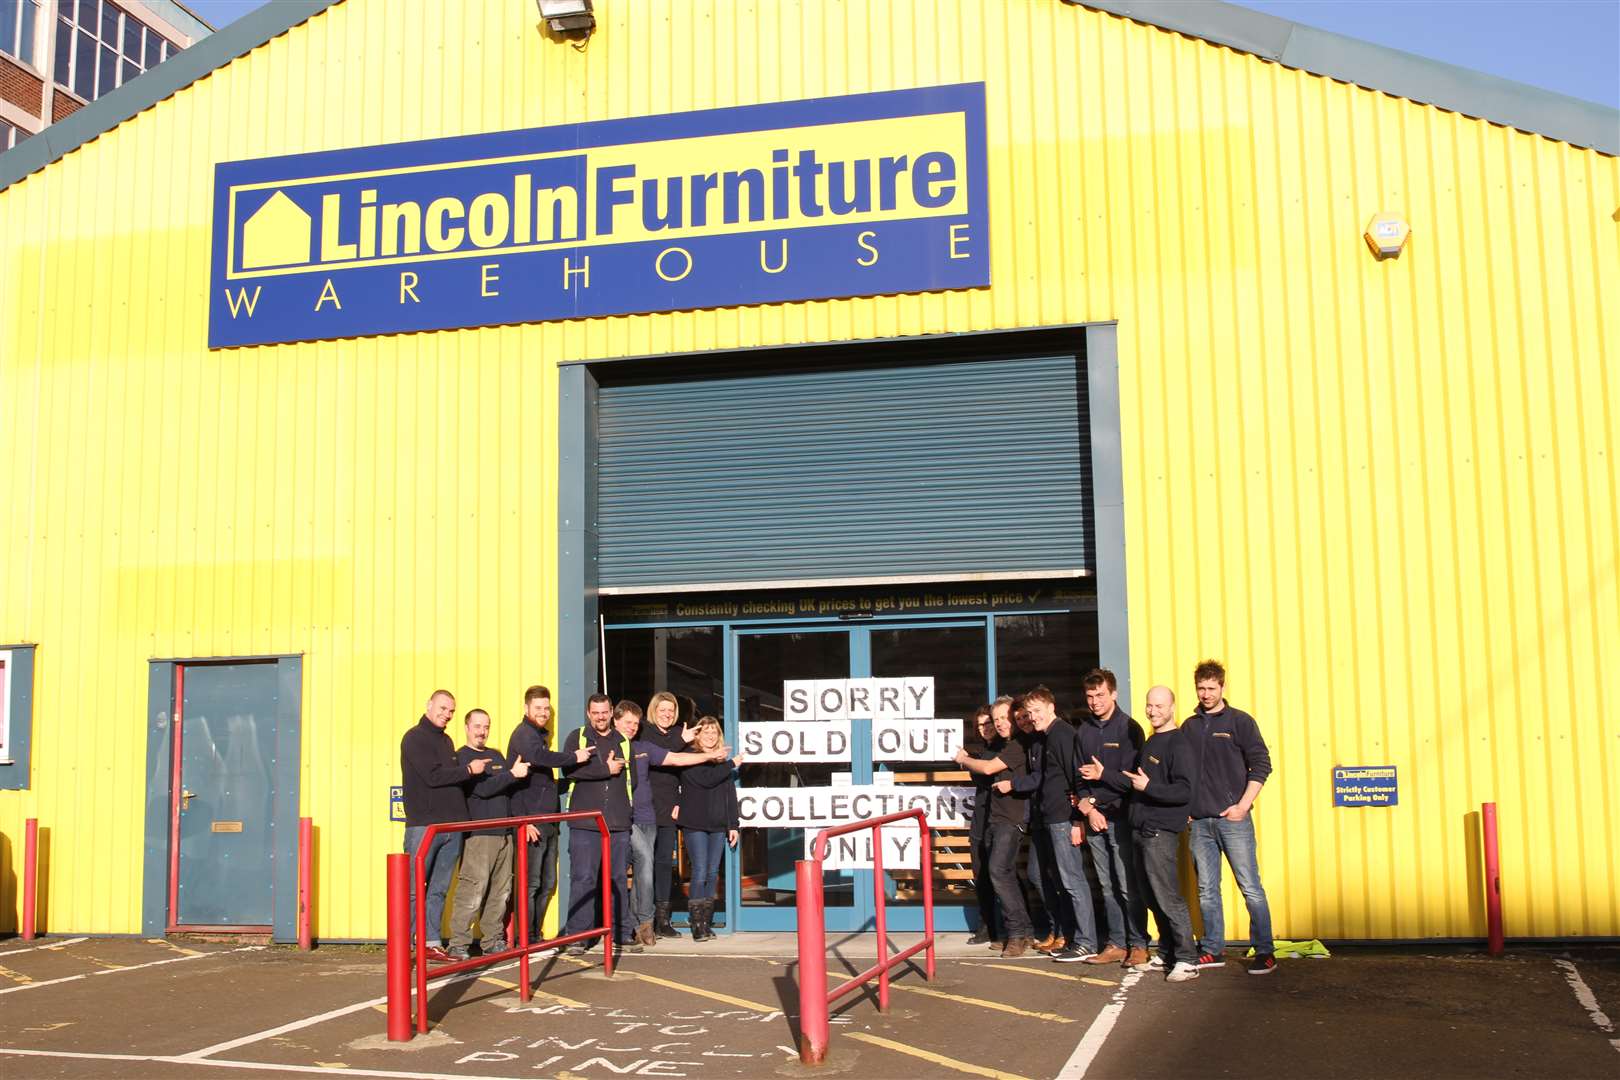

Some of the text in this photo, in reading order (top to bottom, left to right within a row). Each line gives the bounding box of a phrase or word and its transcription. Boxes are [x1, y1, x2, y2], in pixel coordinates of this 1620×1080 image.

[321, 149, 956, 261] Lincoln Furniture
[224, 224, 970, 319] WAREHOUSE
[676, 602, 738, 616] Constantly
[742, 600, 795, 615] checking
[799, 599, 816, 612] UK
[818, 598, 856, 614] prices
[859, 598, 872, 610] to
[875, 597, 895, 611] get
[899, 596, 920, 610] you
[924, 594, 944, 607] the
[947, 593, 988, 606] lowest
[991, 591, 1023, 606] price
[790, 686, 928, 713] SORRY
[745, 728, 956, 755] SOLD OUT
[1336, 786, 1361, 794] Strictly
[1343, 794, 1389, 803] Parking Only
[738, 794, 977, 822] COLLECTIONS
[809, 836, 913, 863] ONLY
[454, 1051, 704, 1076] PINE
